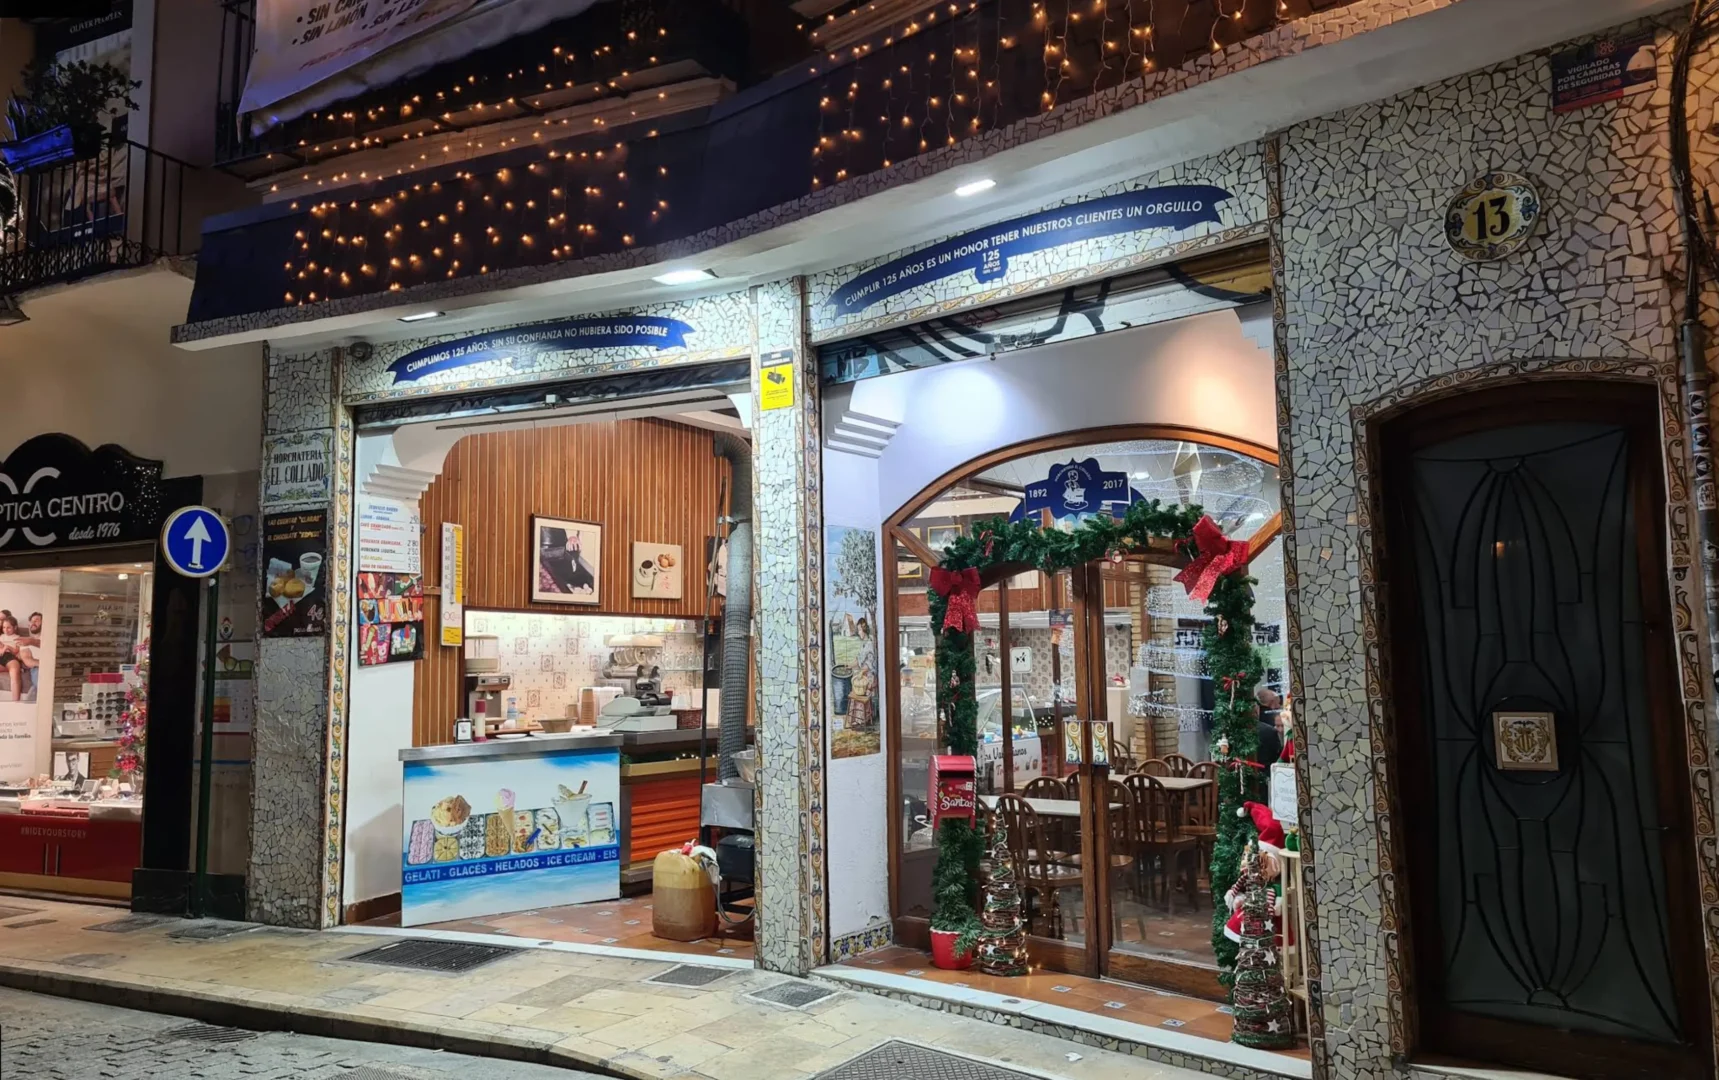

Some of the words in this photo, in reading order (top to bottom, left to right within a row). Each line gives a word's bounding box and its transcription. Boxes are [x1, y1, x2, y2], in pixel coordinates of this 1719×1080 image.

[300, 26, 322, 45] SIN
[325, 3, 368, 35] LIMÓN
[307, 3, 330, 25] SIN
[1567, 57, 1610, 74] VIGILADO
[1557, 75, 1576, 85] POR
[1557, 84, 1570, 92] DE
[1570, 69, 1621, 88] SEGURIDAD
[1472, 195, 1510, 241] 13
[845, 281, 881, 307] CUMPLIR
[881, 271, 898, 288] 125
[899, 259, 925, 280] AÑOS
[926, 254, 937, 270] ES
[938, 249, 952, 265] UN
[953, 238, 990, 261] HONOR
[991, 228, 1020, 250] TENER
[1022, 216, 1072, 239] NUESTROS
[1075, 207, 1123, 227] CLIENTES
[1126, 205, 1143, 218] UN
[1145, 199, 1203, 215] ORGULLO
[982, 249, 1000, 263] 125
[406, 351, 450, 373] CUMPLIMOS
[452, 347, 465, 359] 125
[491, 338, 504, 349] SIN
[505, 336, 515, 346] SU
[516, 329, 562, 345] CONFIANZA
[564, 328, 578, 339] NO
[578, 325, 612, 337] HUBIERA
[613, 325, 633, 335] SIDO
[635, 324, 667, 337] POSIBLE
[273, 449, 322, 464] HORCHATERIA
[270, 467, 279, 485] EL
[285, 462, 324, 483] COLLADO
[1028, 489, 1048, 498] 1892
[1103, 479, 1124, 489] 2017
[47, 491, 125, 518] CENTRO
[69, 525, 95, 540] desde
[96, 522, 121, 538] 1976
[404, 870, 441, 883] GELATI
[495, 856, 539, 872] HELADOS
[547, 855, 563, 866] ICE
[564, 851, 596, 864] CREAM
[603, 849, 618, 860] EIS
